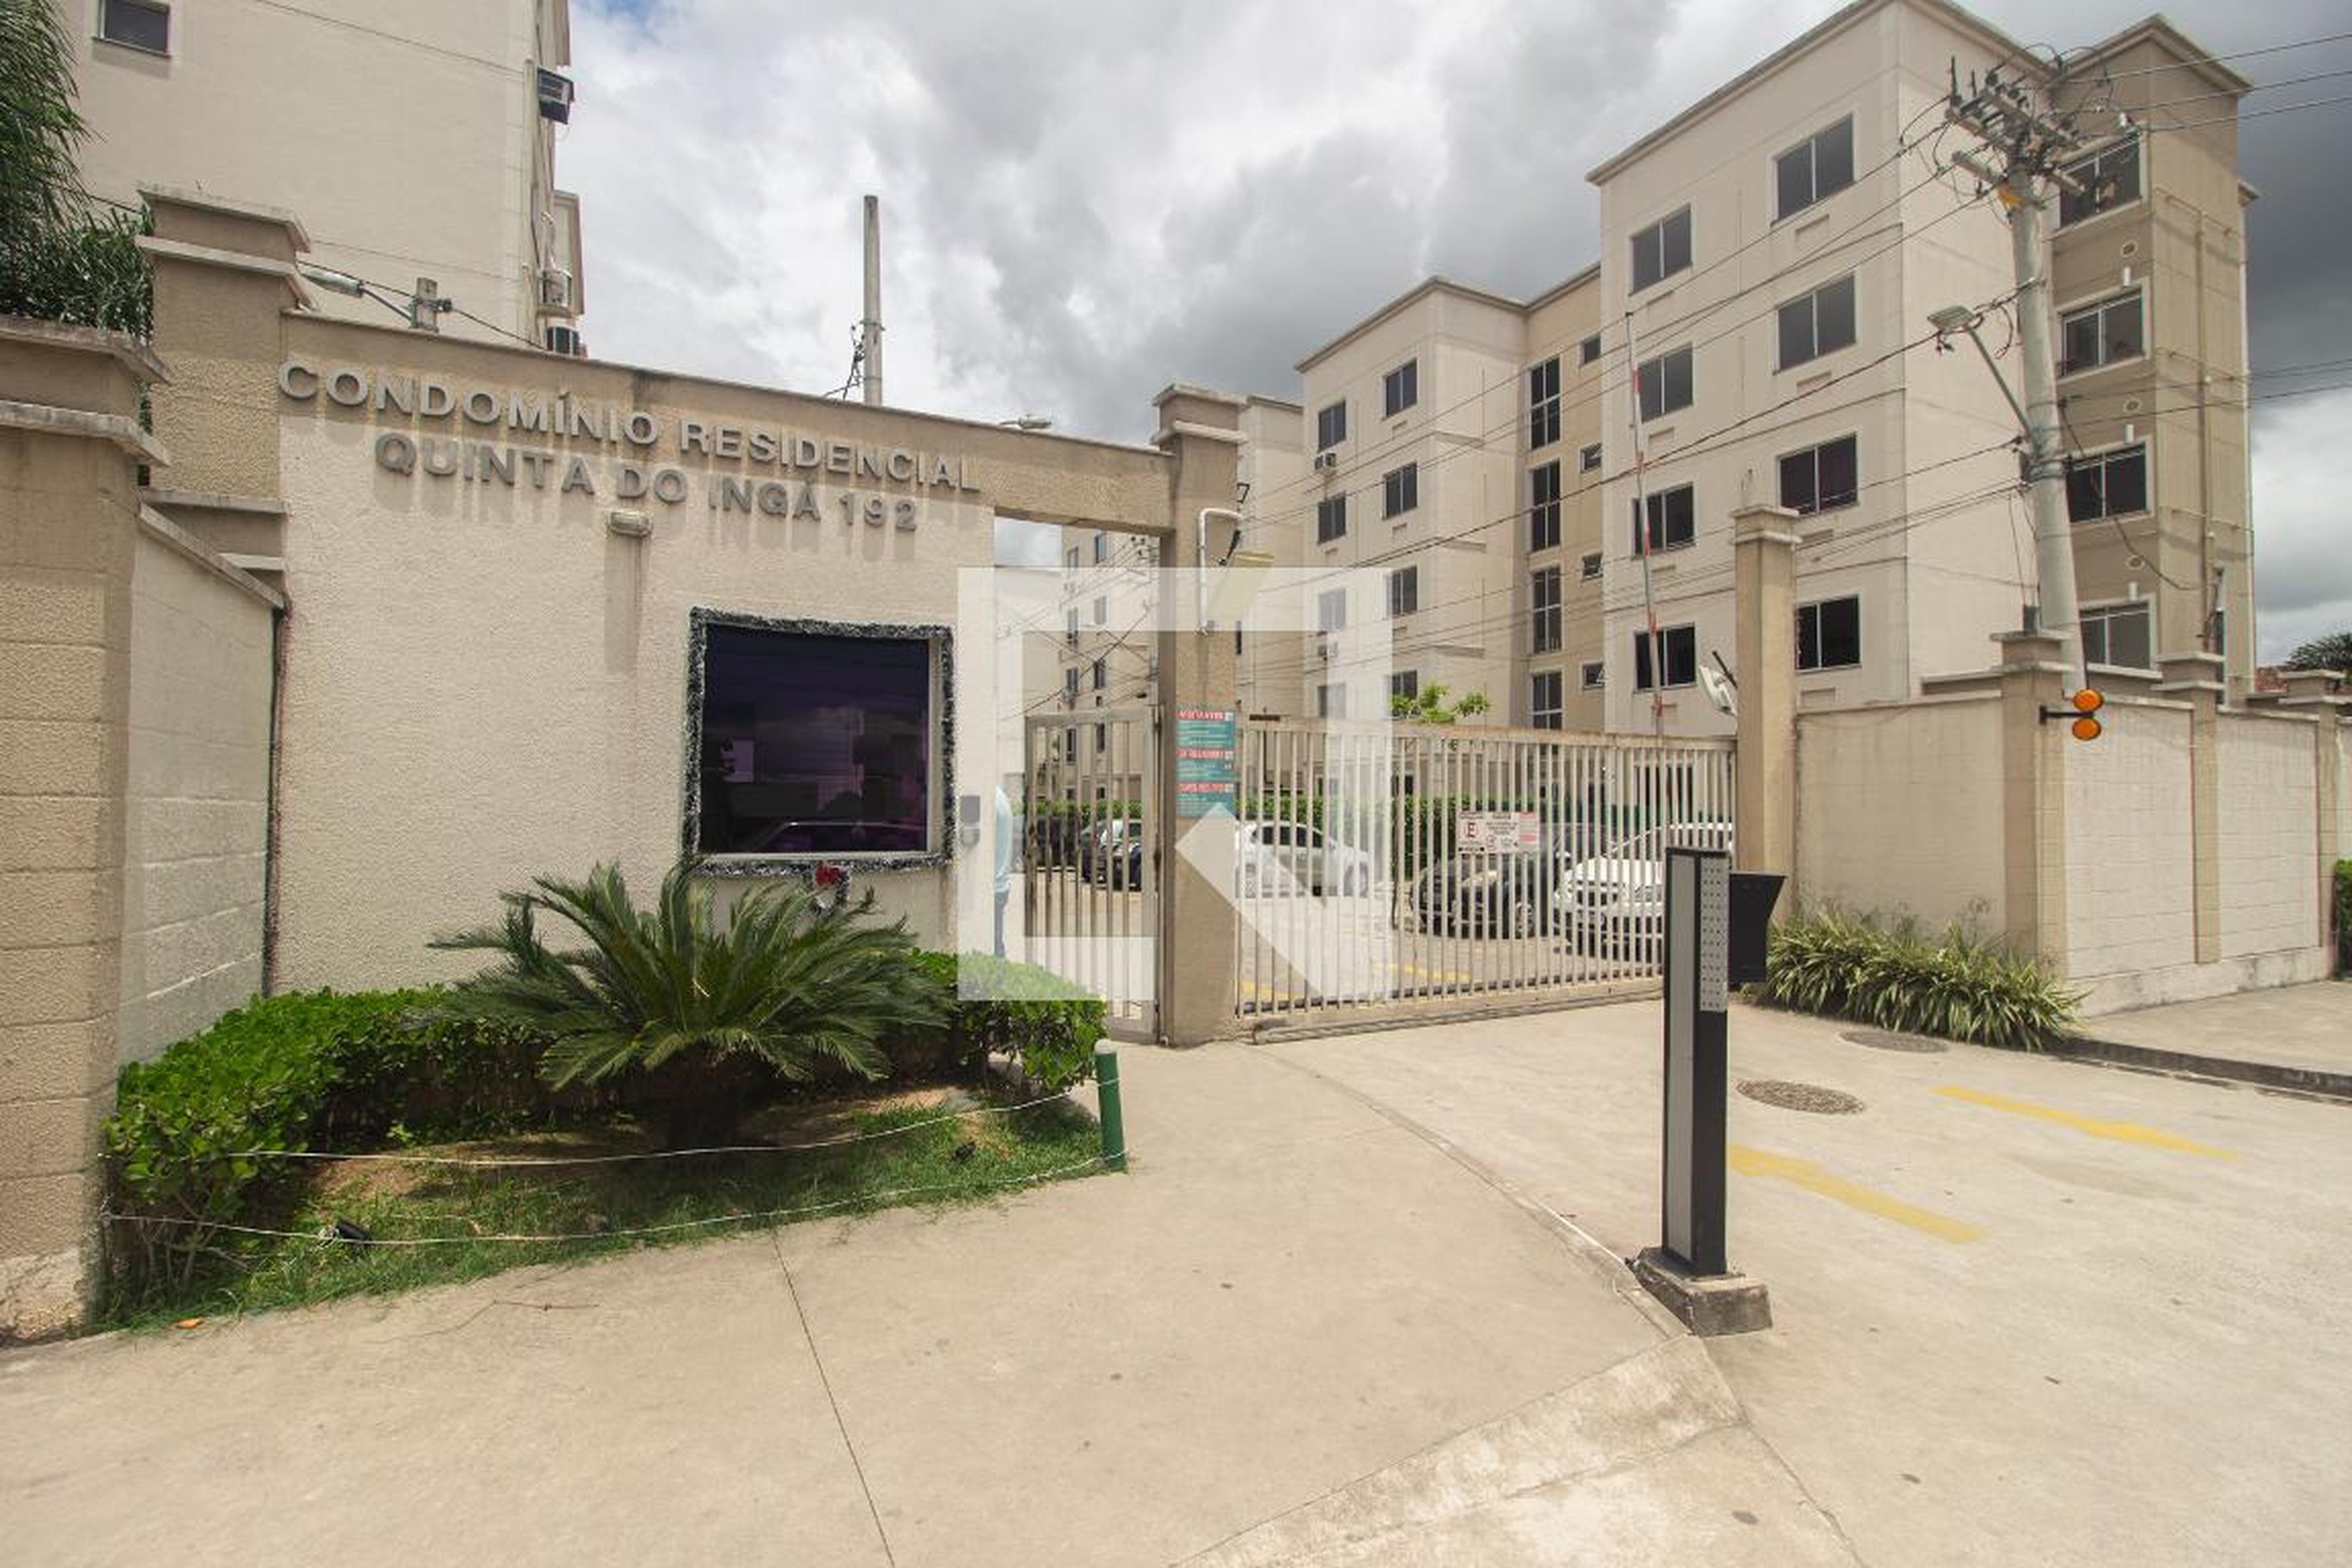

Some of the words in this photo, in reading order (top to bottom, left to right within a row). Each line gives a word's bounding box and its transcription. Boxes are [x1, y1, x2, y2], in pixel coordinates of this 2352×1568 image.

[279, 360, 658, 445] CONDOMÍNIO
[680, 418, 981, 491] RESIDENCIAL
[375, 432, 595, 494] QUINTA
[616, 464, 688, 503] DO
[708, 474, 821, 522] INGÁ
[839, 492, 917, 532] 192
